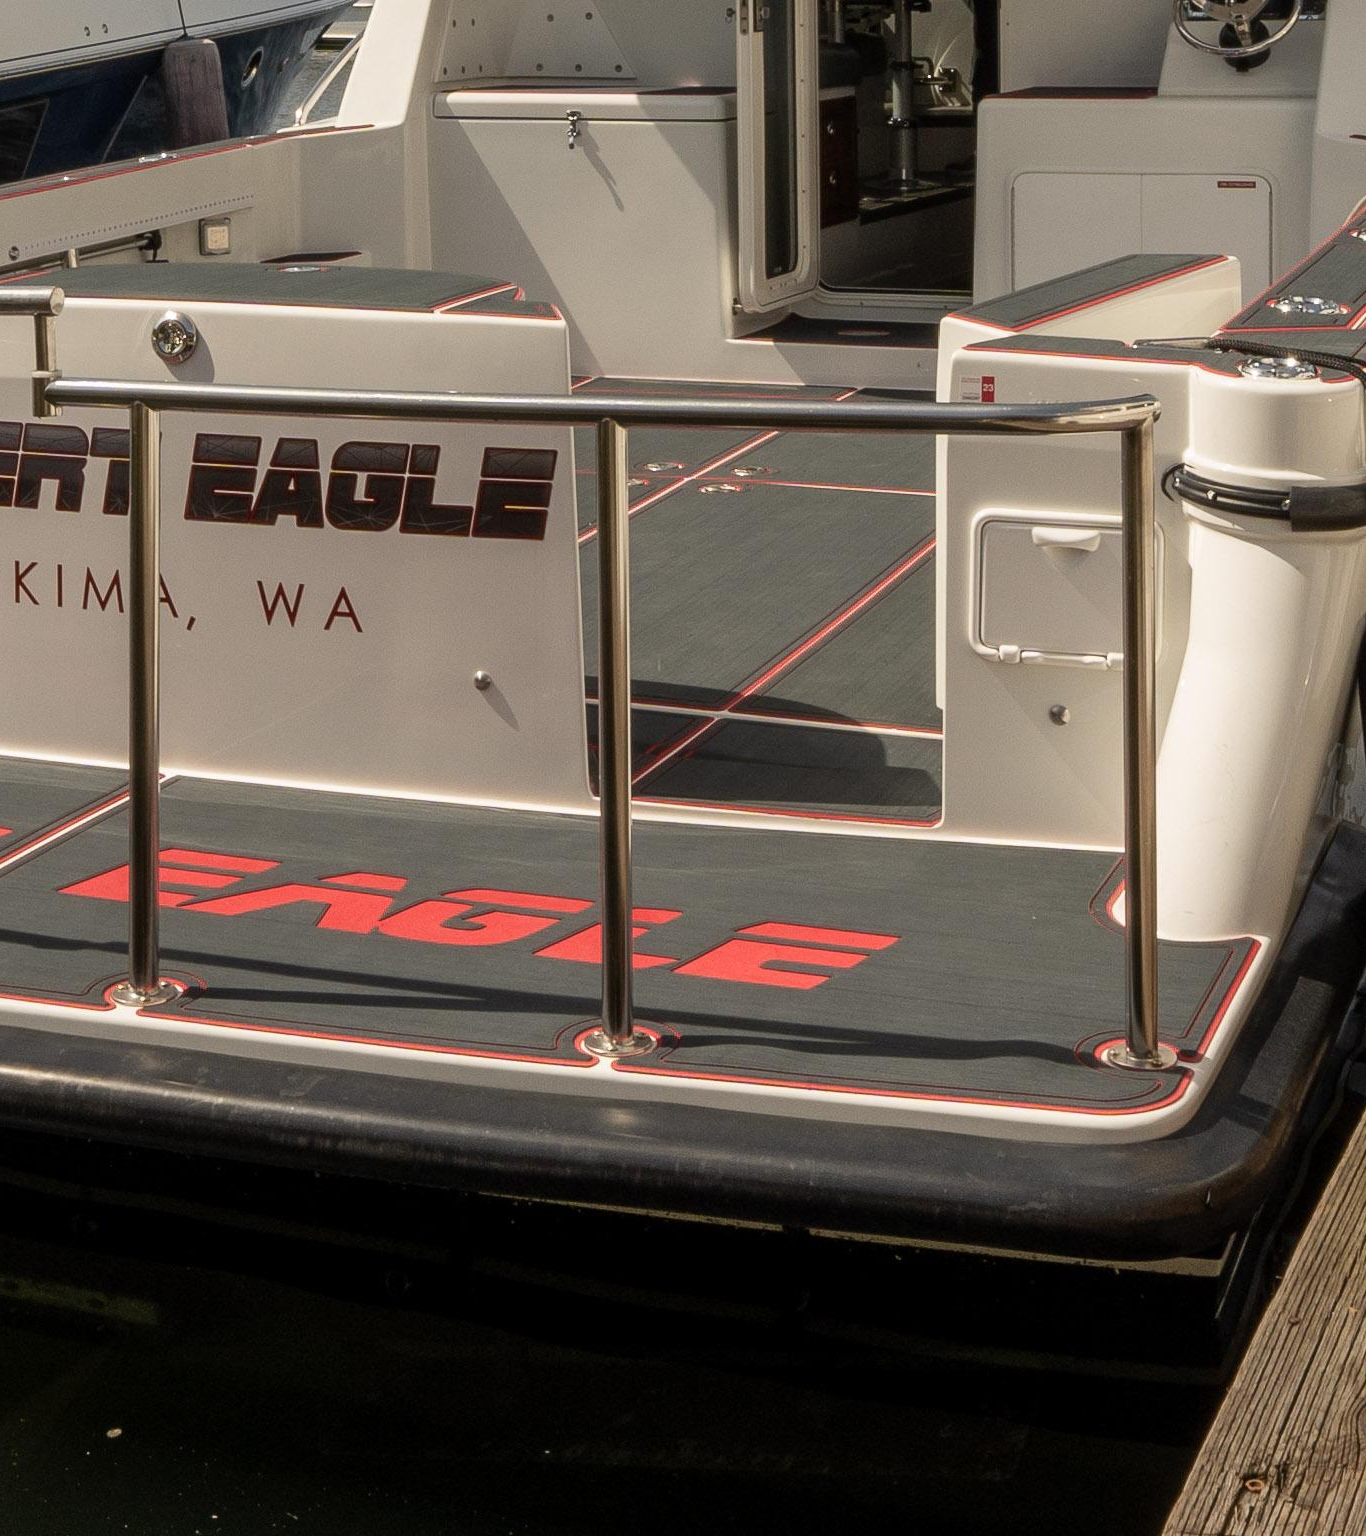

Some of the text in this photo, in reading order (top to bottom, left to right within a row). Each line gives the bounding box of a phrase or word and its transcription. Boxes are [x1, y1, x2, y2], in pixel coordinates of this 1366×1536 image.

[982, 383, 995, 393] 23
[184, 432, 559, 541] EAGLE
[257, 579, 365, 635] WA
[57, 847, 902, 990] EAGLE
